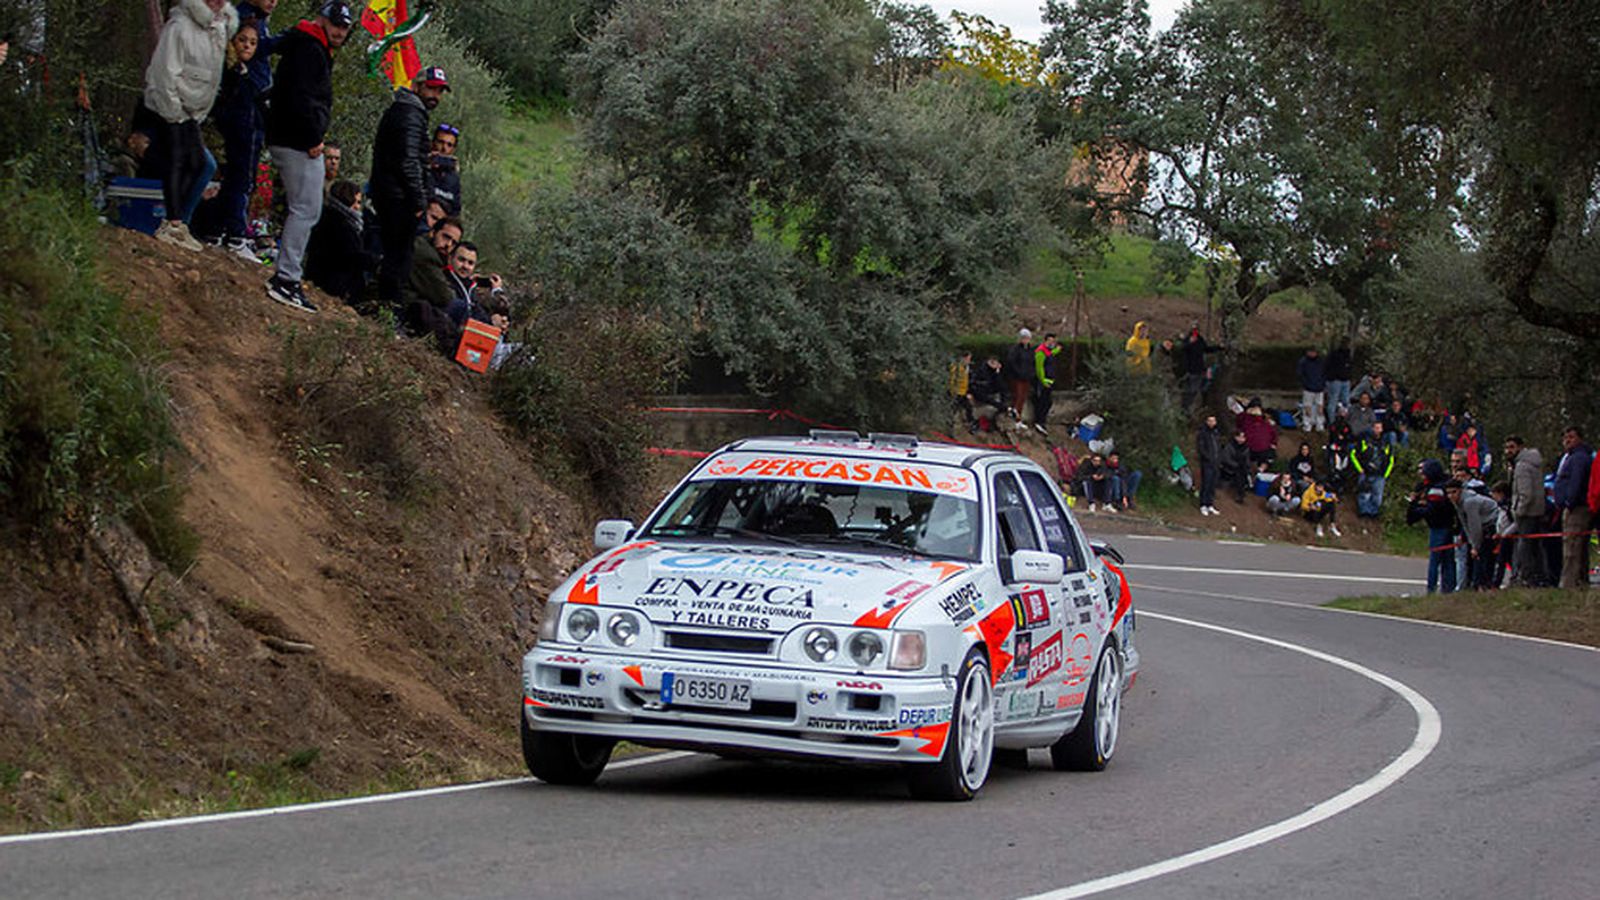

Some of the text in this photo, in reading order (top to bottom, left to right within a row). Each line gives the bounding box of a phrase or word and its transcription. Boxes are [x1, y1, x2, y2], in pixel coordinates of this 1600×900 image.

[737, 458, 933, 489] PERCASAN
[645, 577, 815, 608] ENPECA
[938, 581, 983, 617] HEMPEL
[634, 597, 678, 607] COMPRA
[692, 601, 725, 611] VENTA
[729, 602, 742, 612] DE
[672, 611, 770, 629] Y TALLERES
[688, 680, 727, 700] 6350
[730, 685, 749, 703] AZ
[807, 717, 846, 731] ANTONIO
[900, 708, 936, 724] DEPUR
